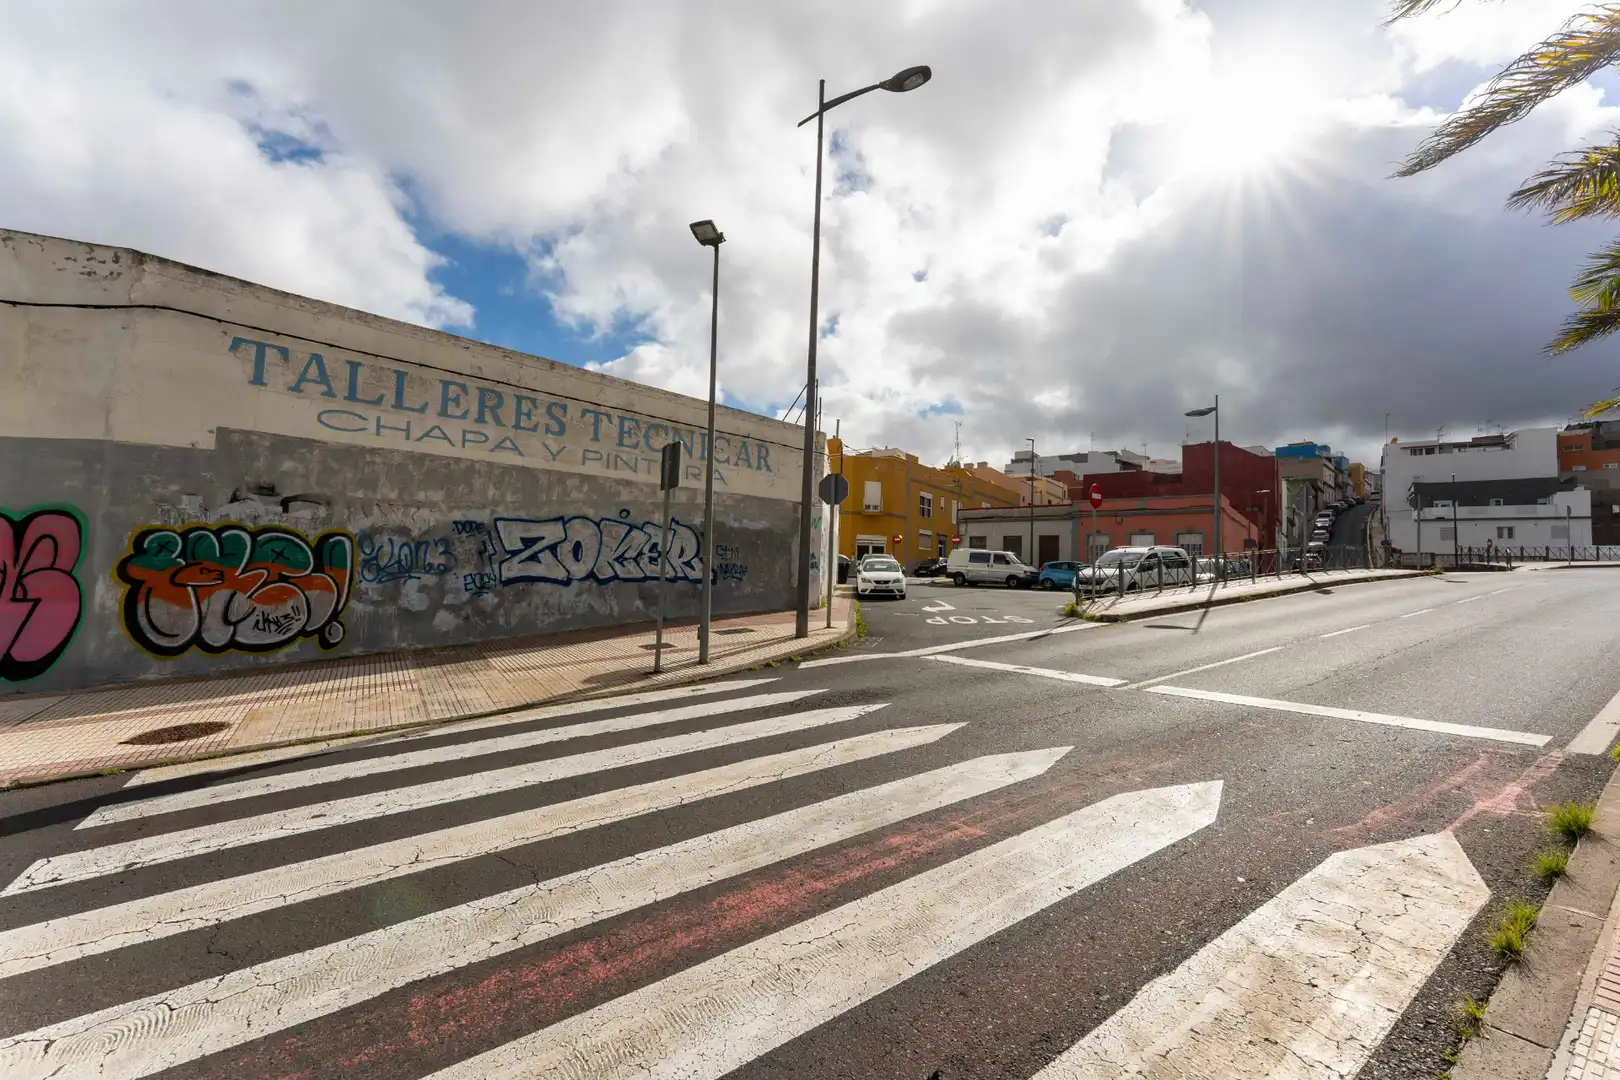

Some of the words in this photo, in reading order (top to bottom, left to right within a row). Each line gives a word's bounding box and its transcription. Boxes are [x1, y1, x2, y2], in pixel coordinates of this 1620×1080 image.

[228, 337, 568, 437] TALLERES
[580, 408, 773, 473] TECNICAR
[317, 409, 525, 457] CHAPA
[541, 441, 568, 461] Y
[582, 448, 729, 485] PINTRA
[925, 615, 1035, 625] STOP
